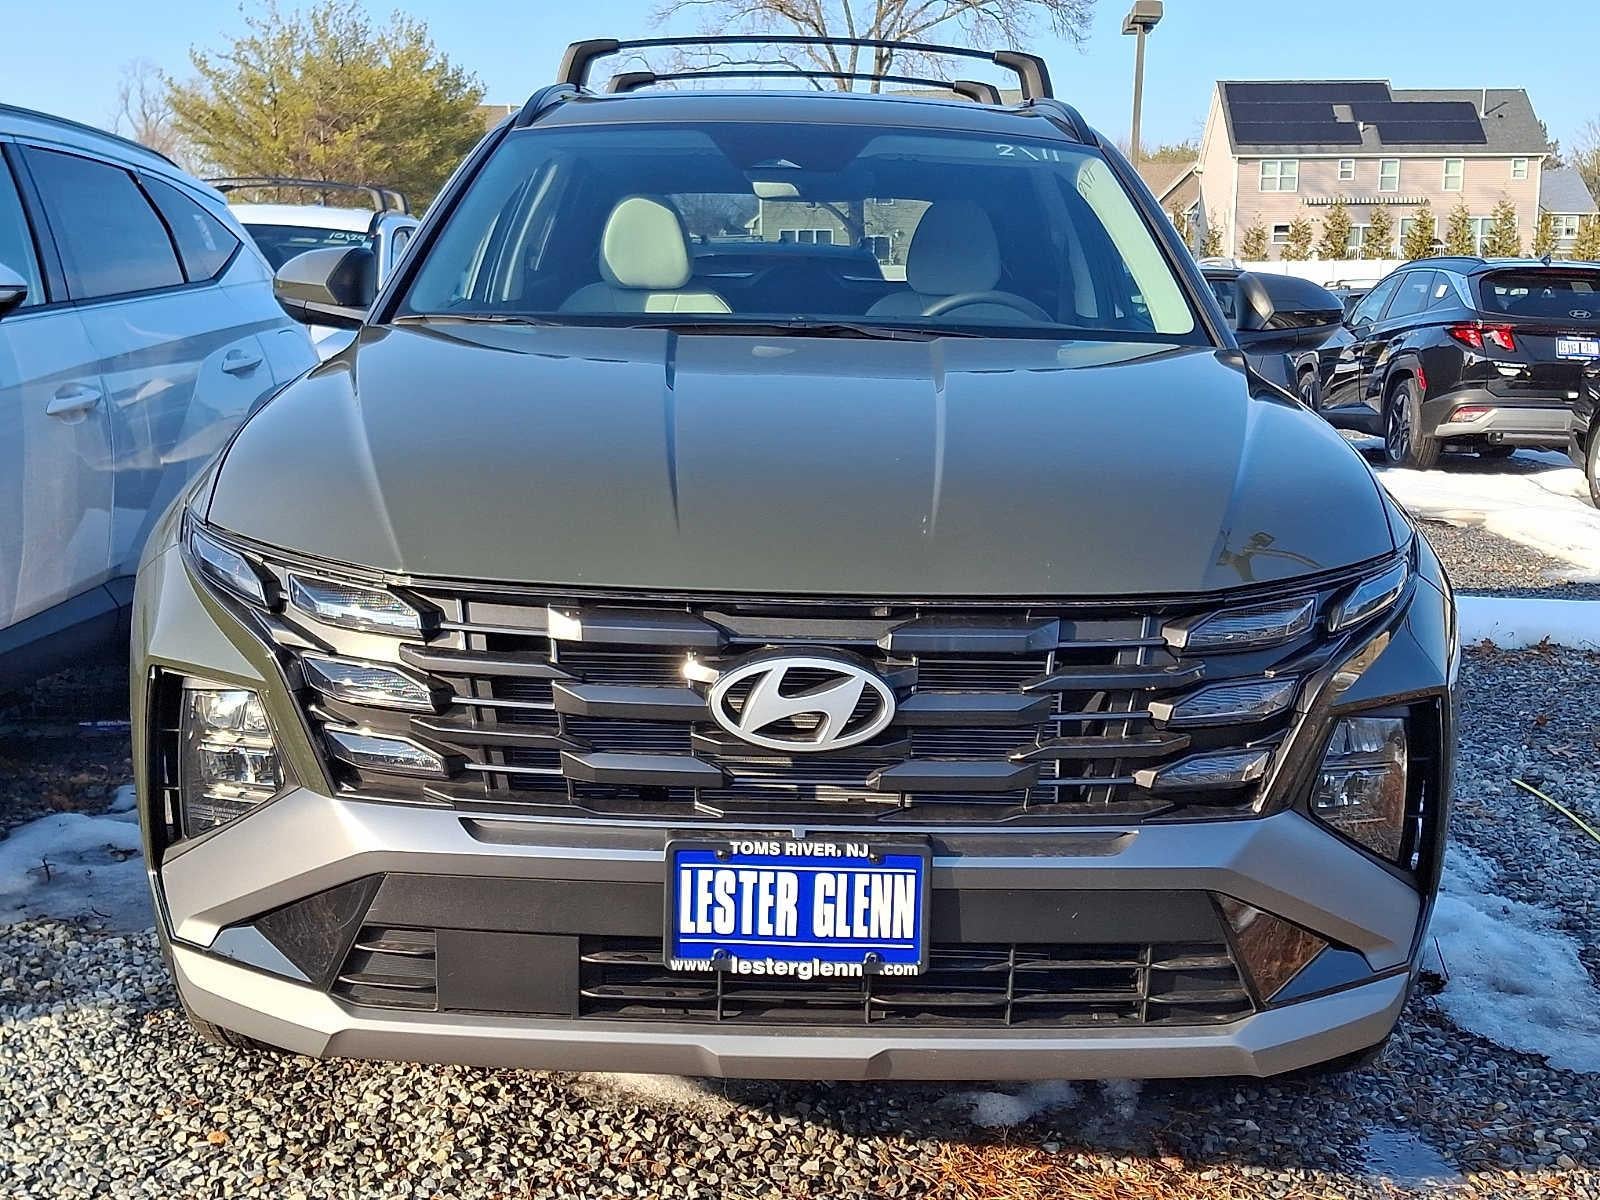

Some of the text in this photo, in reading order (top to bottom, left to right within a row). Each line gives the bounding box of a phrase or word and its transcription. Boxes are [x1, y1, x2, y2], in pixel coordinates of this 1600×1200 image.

[729, 841, 869, 858] TOMS RIVER, NJ
[680, 869, 916, 939] LESTER GLENN
